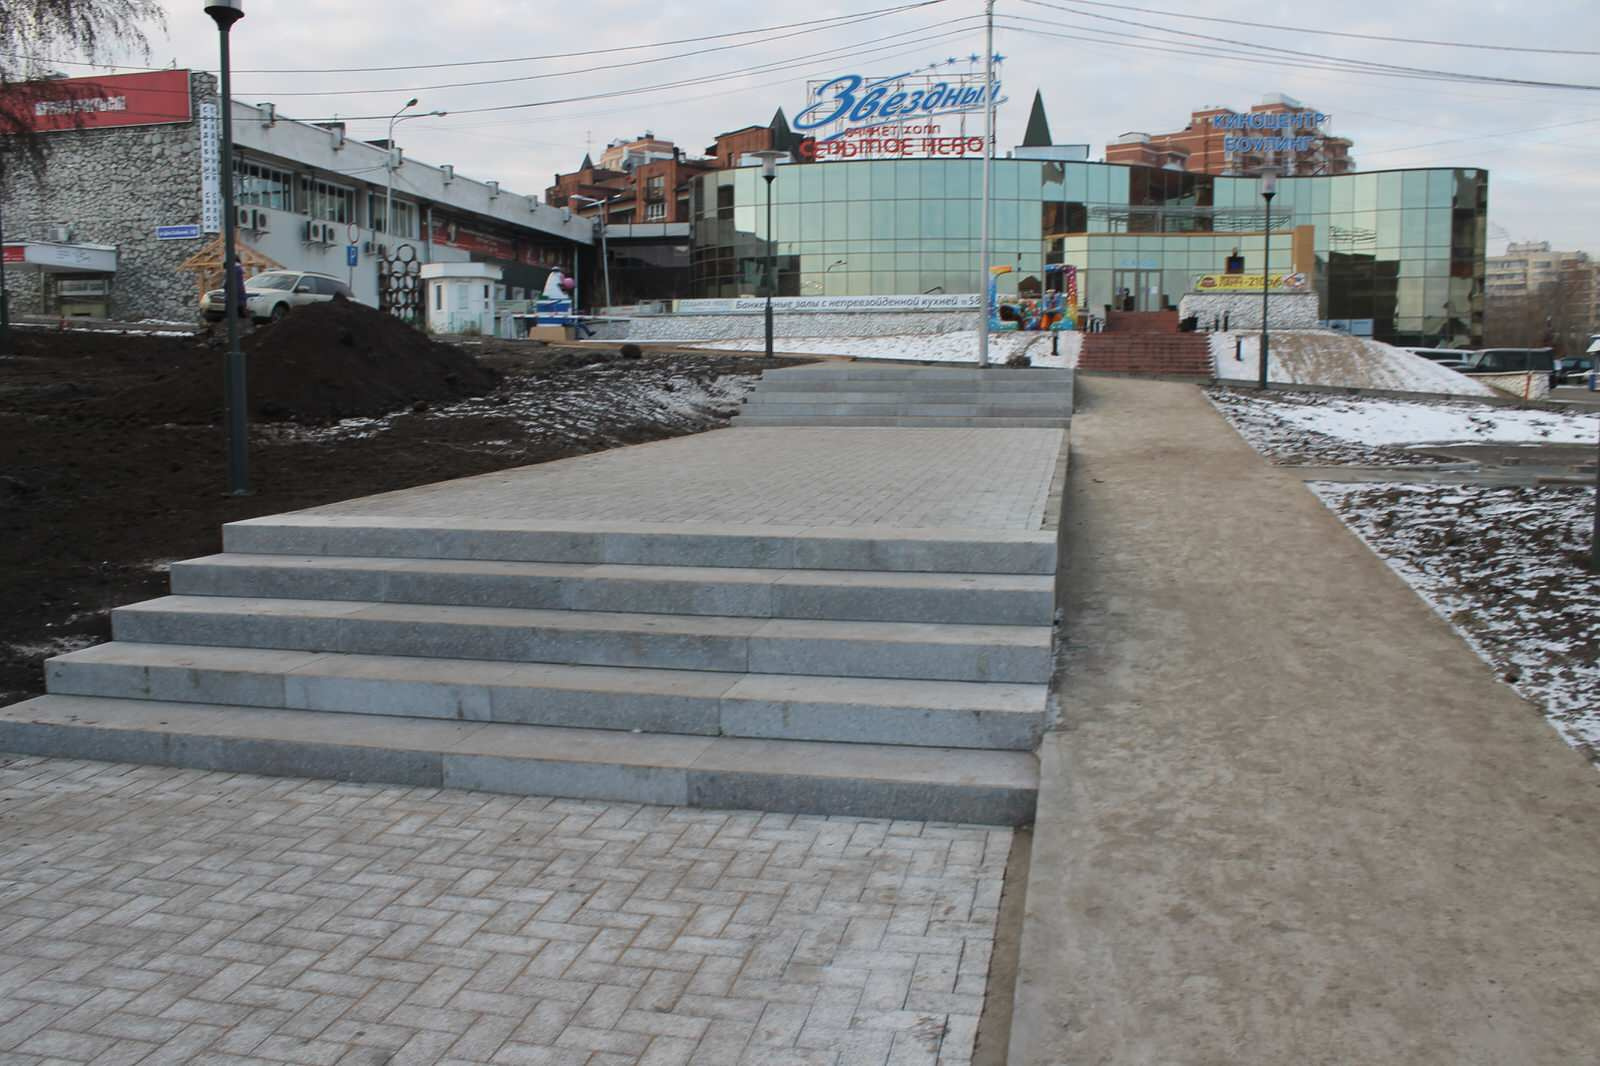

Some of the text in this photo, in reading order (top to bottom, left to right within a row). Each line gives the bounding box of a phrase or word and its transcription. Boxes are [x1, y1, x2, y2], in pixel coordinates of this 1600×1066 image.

[1213, 111, 1325, 130] КИНОЦЕНТР
[922, 136, 985, 156] НЕБО
[1224, 135, 1314, 152] БОУЛИНГ
[735, 298, 791, 310] Банкеные
